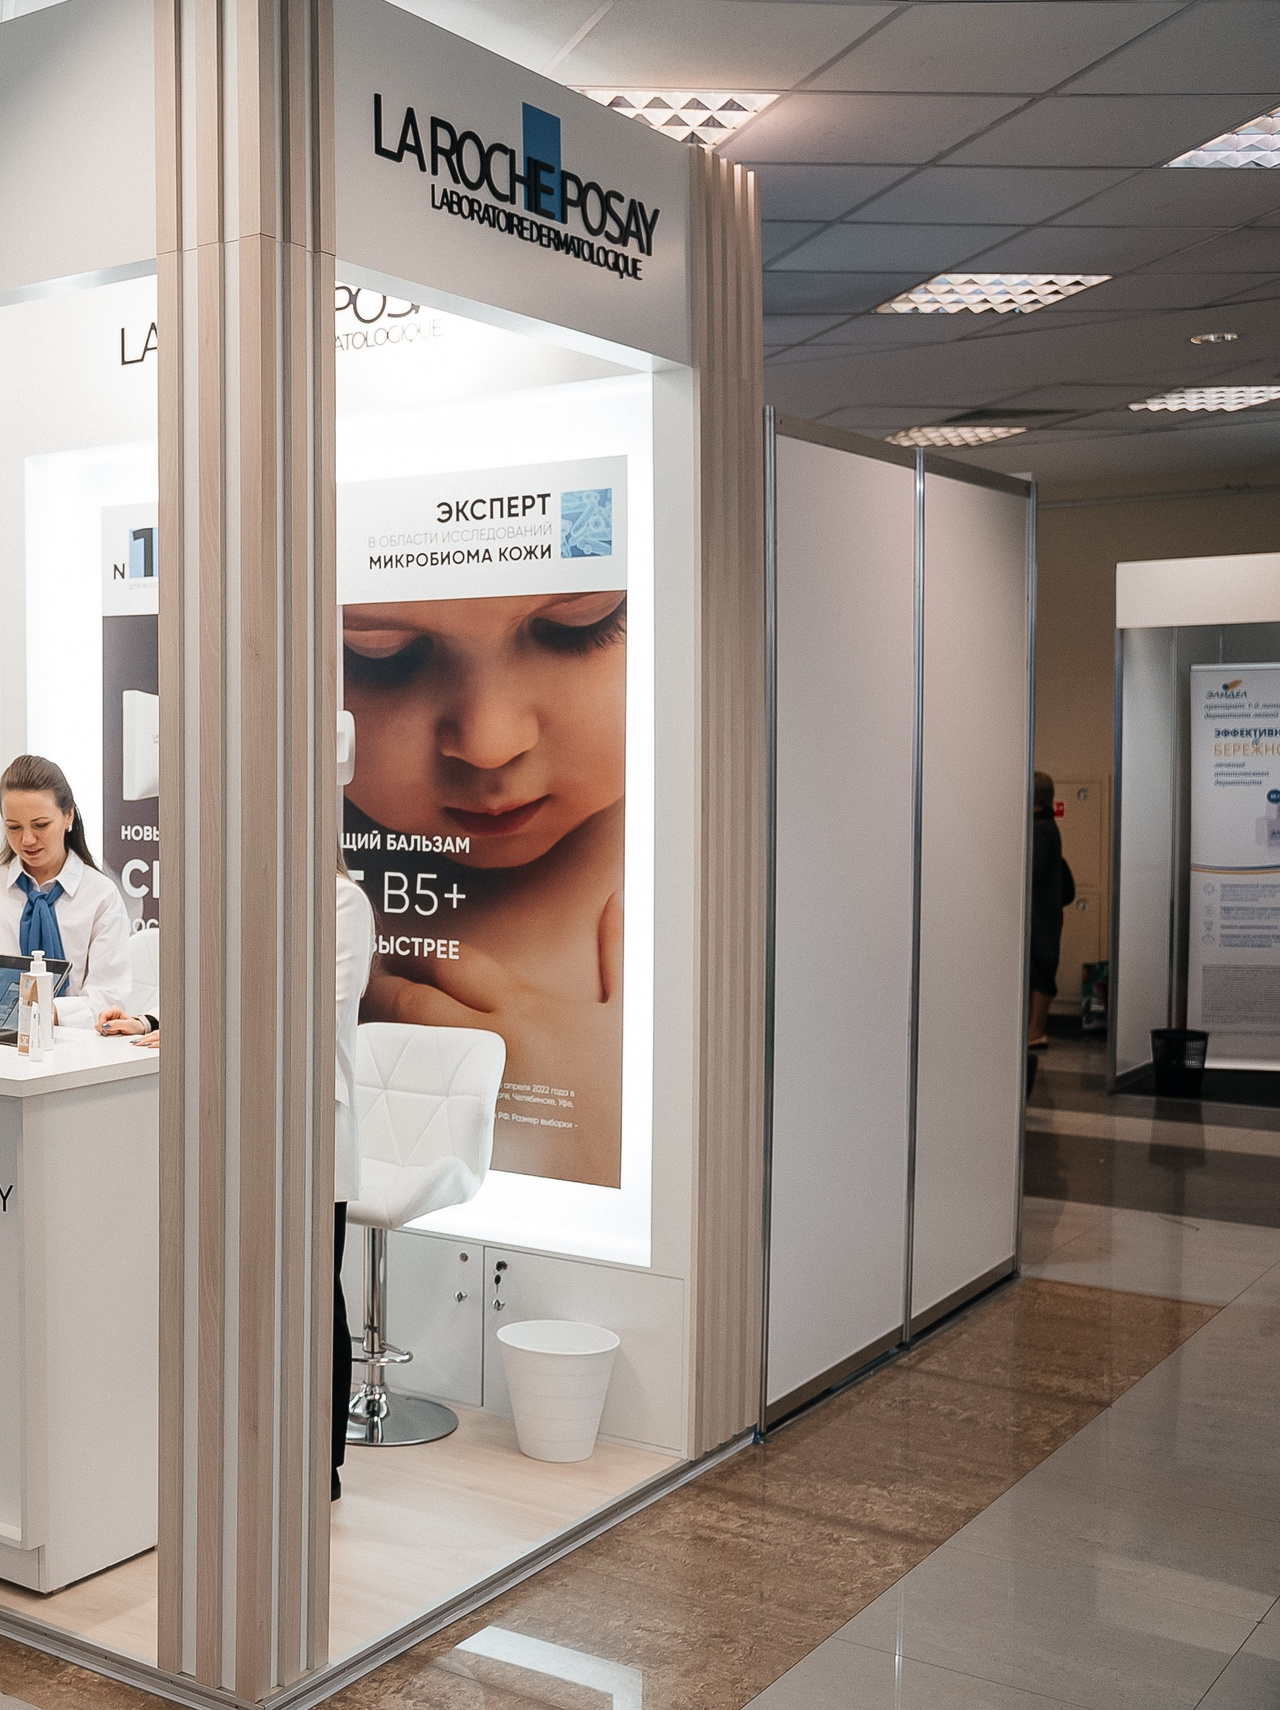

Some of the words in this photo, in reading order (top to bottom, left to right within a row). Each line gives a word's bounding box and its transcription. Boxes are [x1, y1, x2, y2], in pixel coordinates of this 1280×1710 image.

[373, 92, 427, 173] LA
[430, 115, 556, 220] ROCHE
[560, 169, 661, 257] POSAY
[430, 183, 530, 241] LABORATOIRE
[529, 222, 643, 281] DERMATOLOGIQUE
[436, 492, 551, 523] ЭКСПЕРТ
[368, 536, 376, 549] В
[379, 531, 439, 548] ОБЛАСТИ
[441, 521, 552, 544] ИССЛЕДОВАНИЙ
[369, 548, 493, 570] МИКРОБИОМА
[498, 543, 552, 562] КОЖИ
[386, 834, 470, 853] БАЛЬЗАМ
[383, 871, 466, 916] B5+
[374, 935, 460, 960] ЫСТРЕЕ
